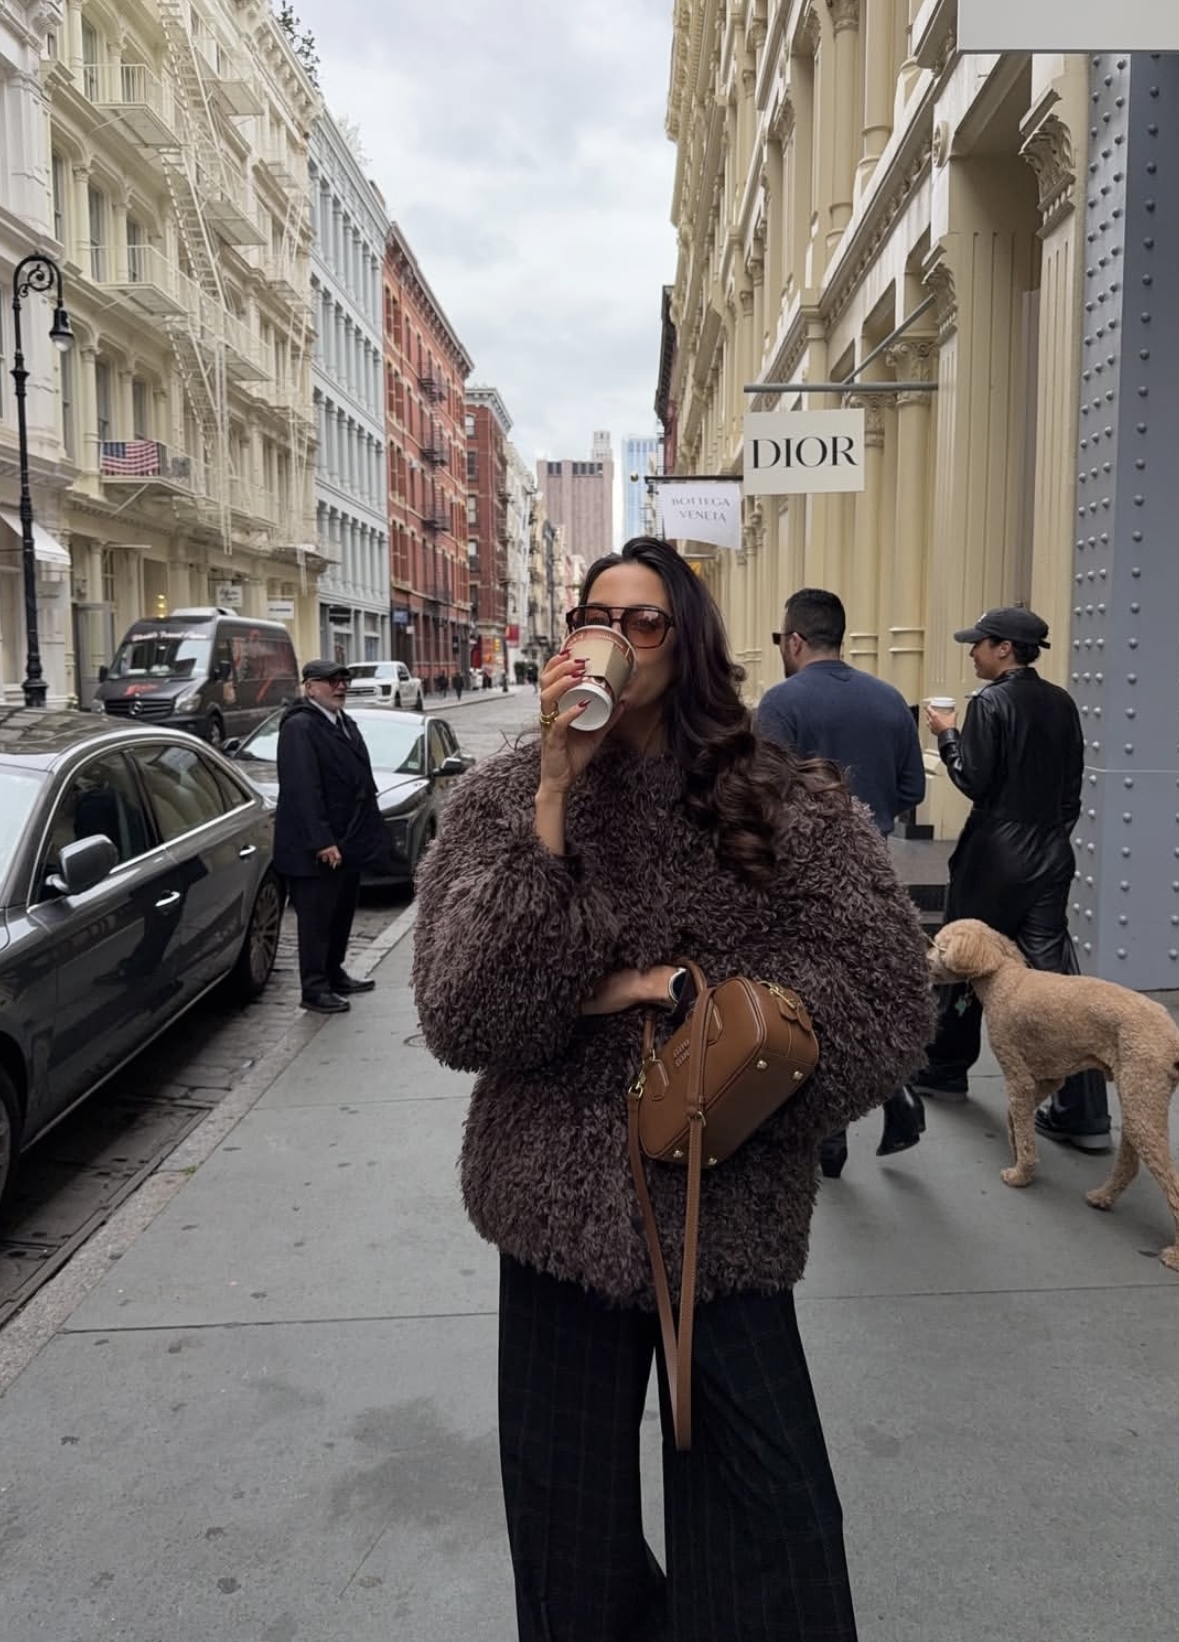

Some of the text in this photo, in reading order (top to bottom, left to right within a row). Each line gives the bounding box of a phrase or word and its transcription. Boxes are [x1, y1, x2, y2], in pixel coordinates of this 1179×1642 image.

[750, 436, 858, 469] DIOR
[672, 497, 730, 506] BOTTEGA
[680, 510, 727, 523] VENETA
